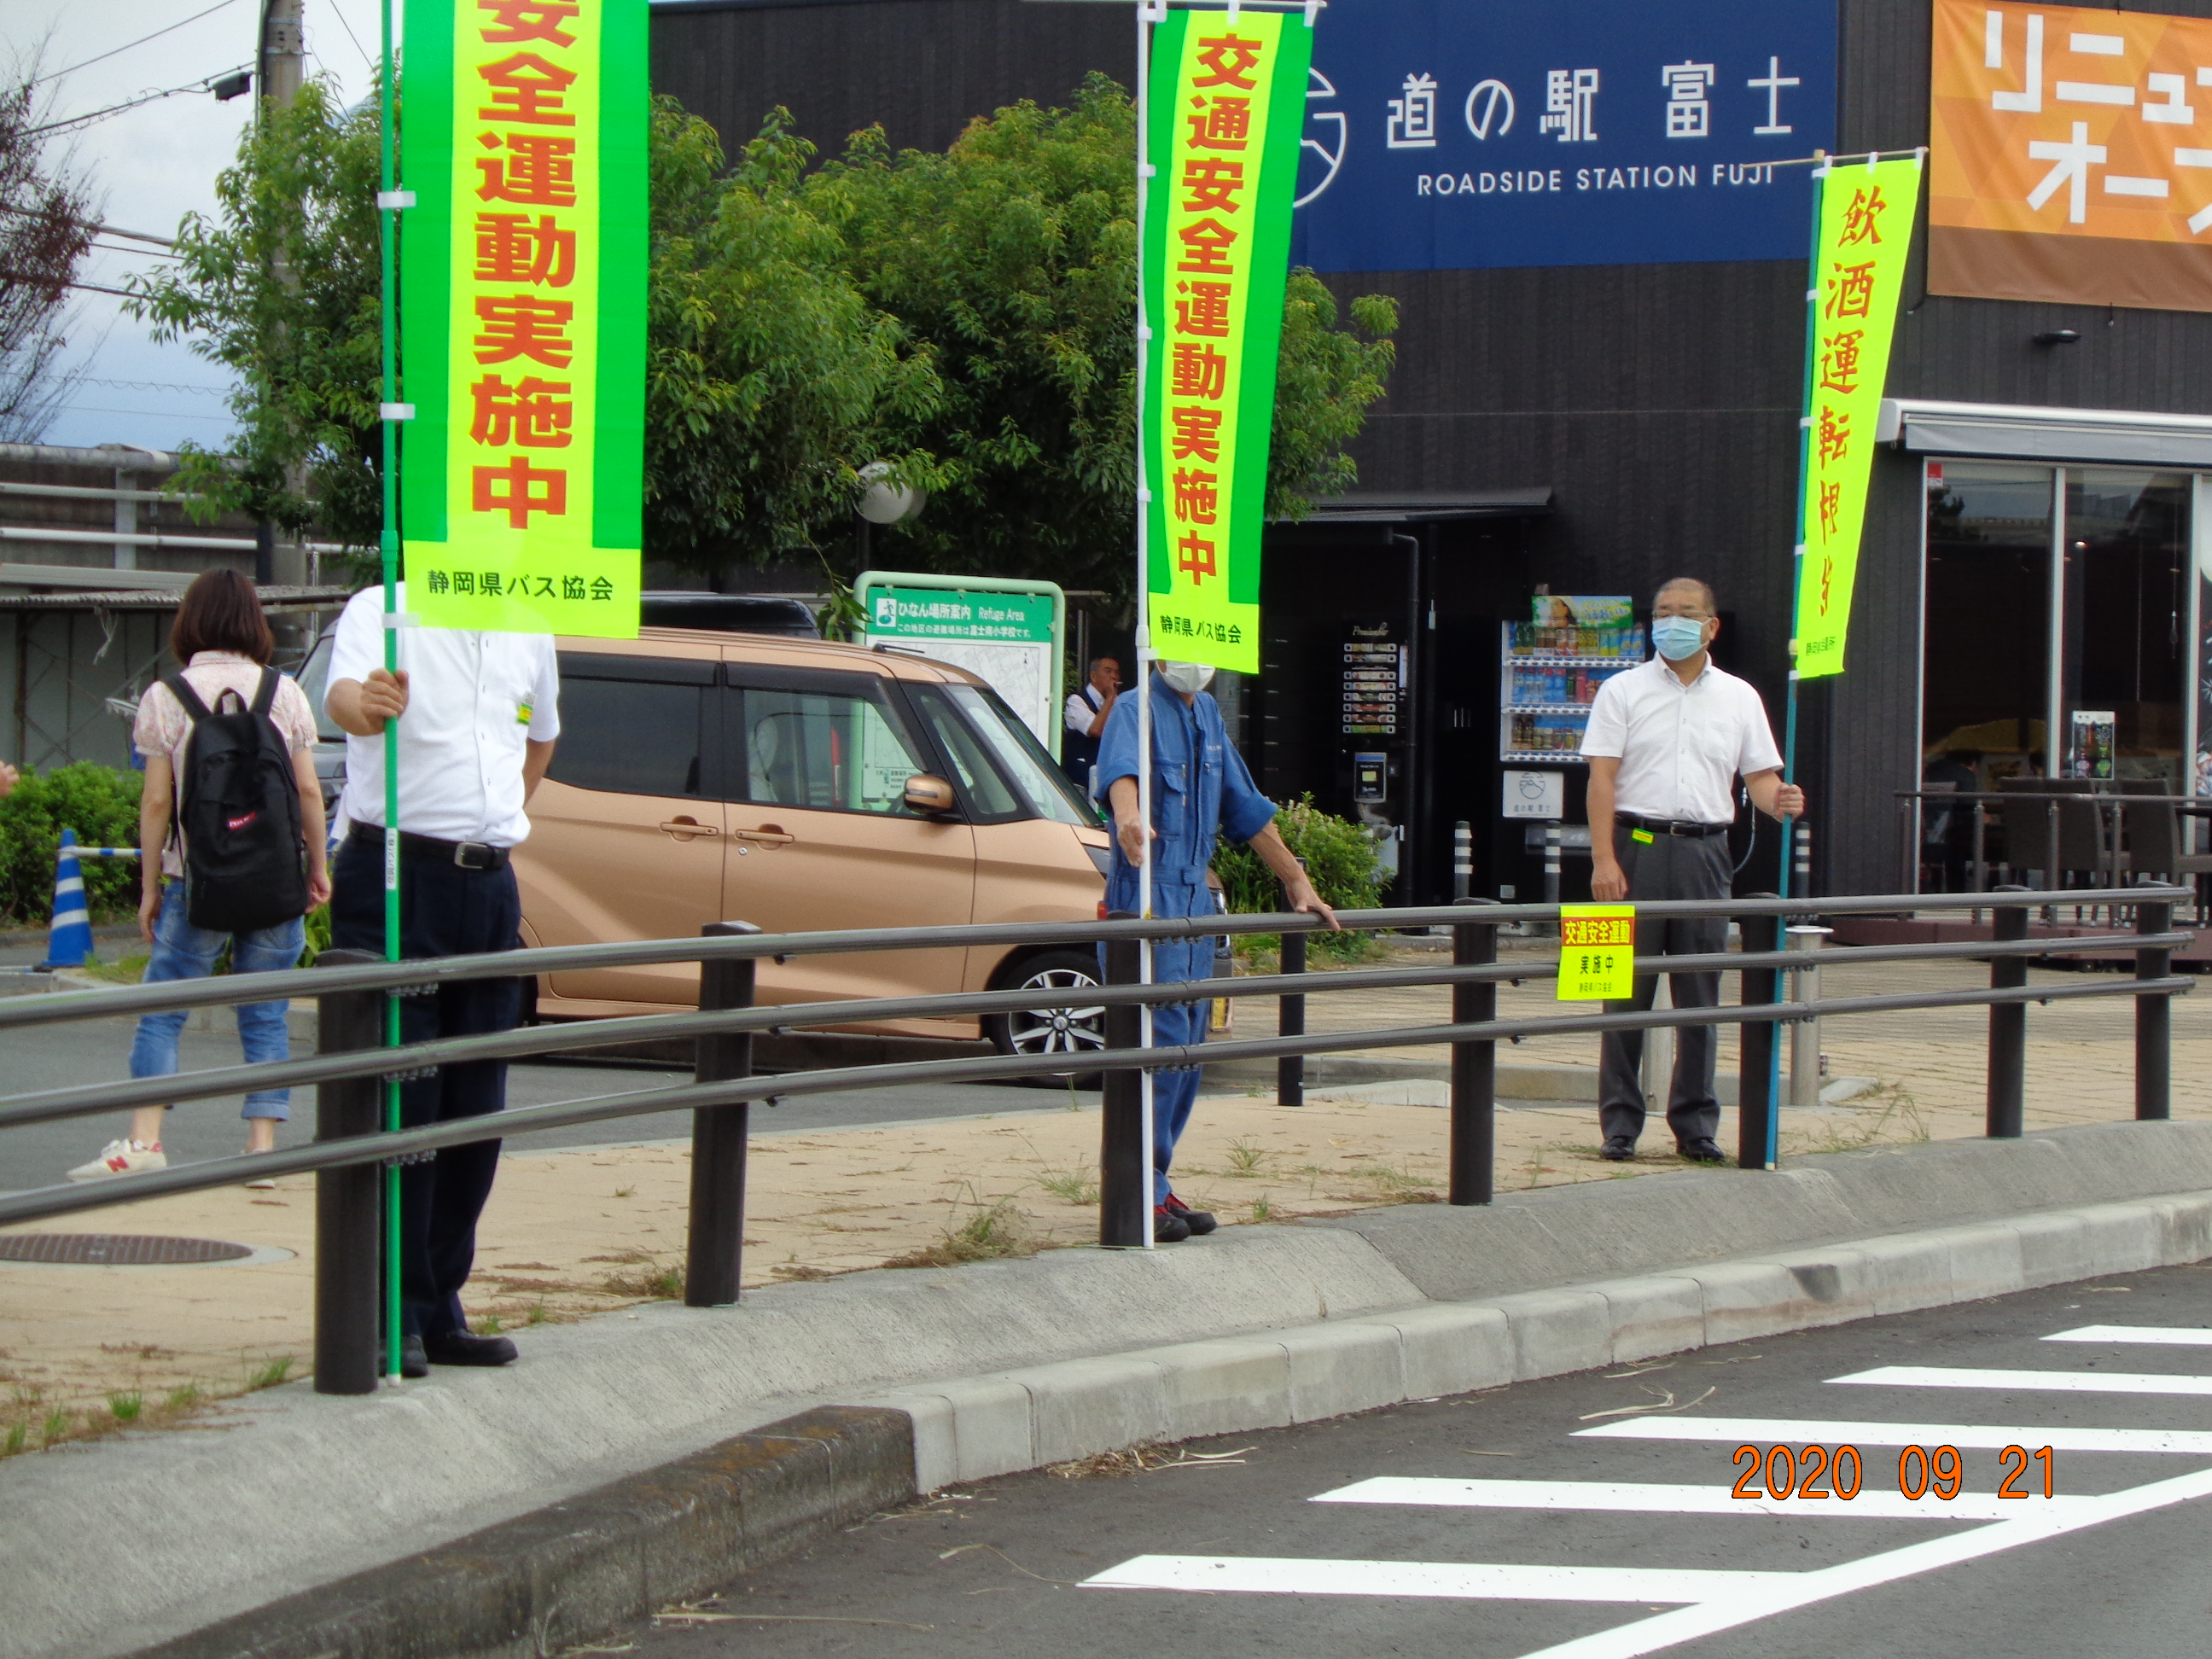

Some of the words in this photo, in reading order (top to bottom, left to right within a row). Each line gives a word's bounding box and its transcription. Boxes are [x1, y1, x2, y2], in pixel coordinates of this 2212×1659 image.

[1985, 10, 2212, 125] リニュ
[1387, 69, 1599, 148] 道の駅
[1662, 56, 1800, 137] 富士
[1417, 169, 1562, 195] ROADSIDE
[1576, 165, 1697, 191] STATION
[1712, 163, 1773, 185] FUJI
[469, 0, 579, 530] 安全運動実施中
[1171, 32, 1263, 587] 交通安全運動実施中
[428, 569, 614, 601] 静岡県バス協会
[978, 607, 1004, 621] Refuge
[1006, 608, 1025, 621] Area
[1160, 614, 1241, 644] 静岡県バス協会
